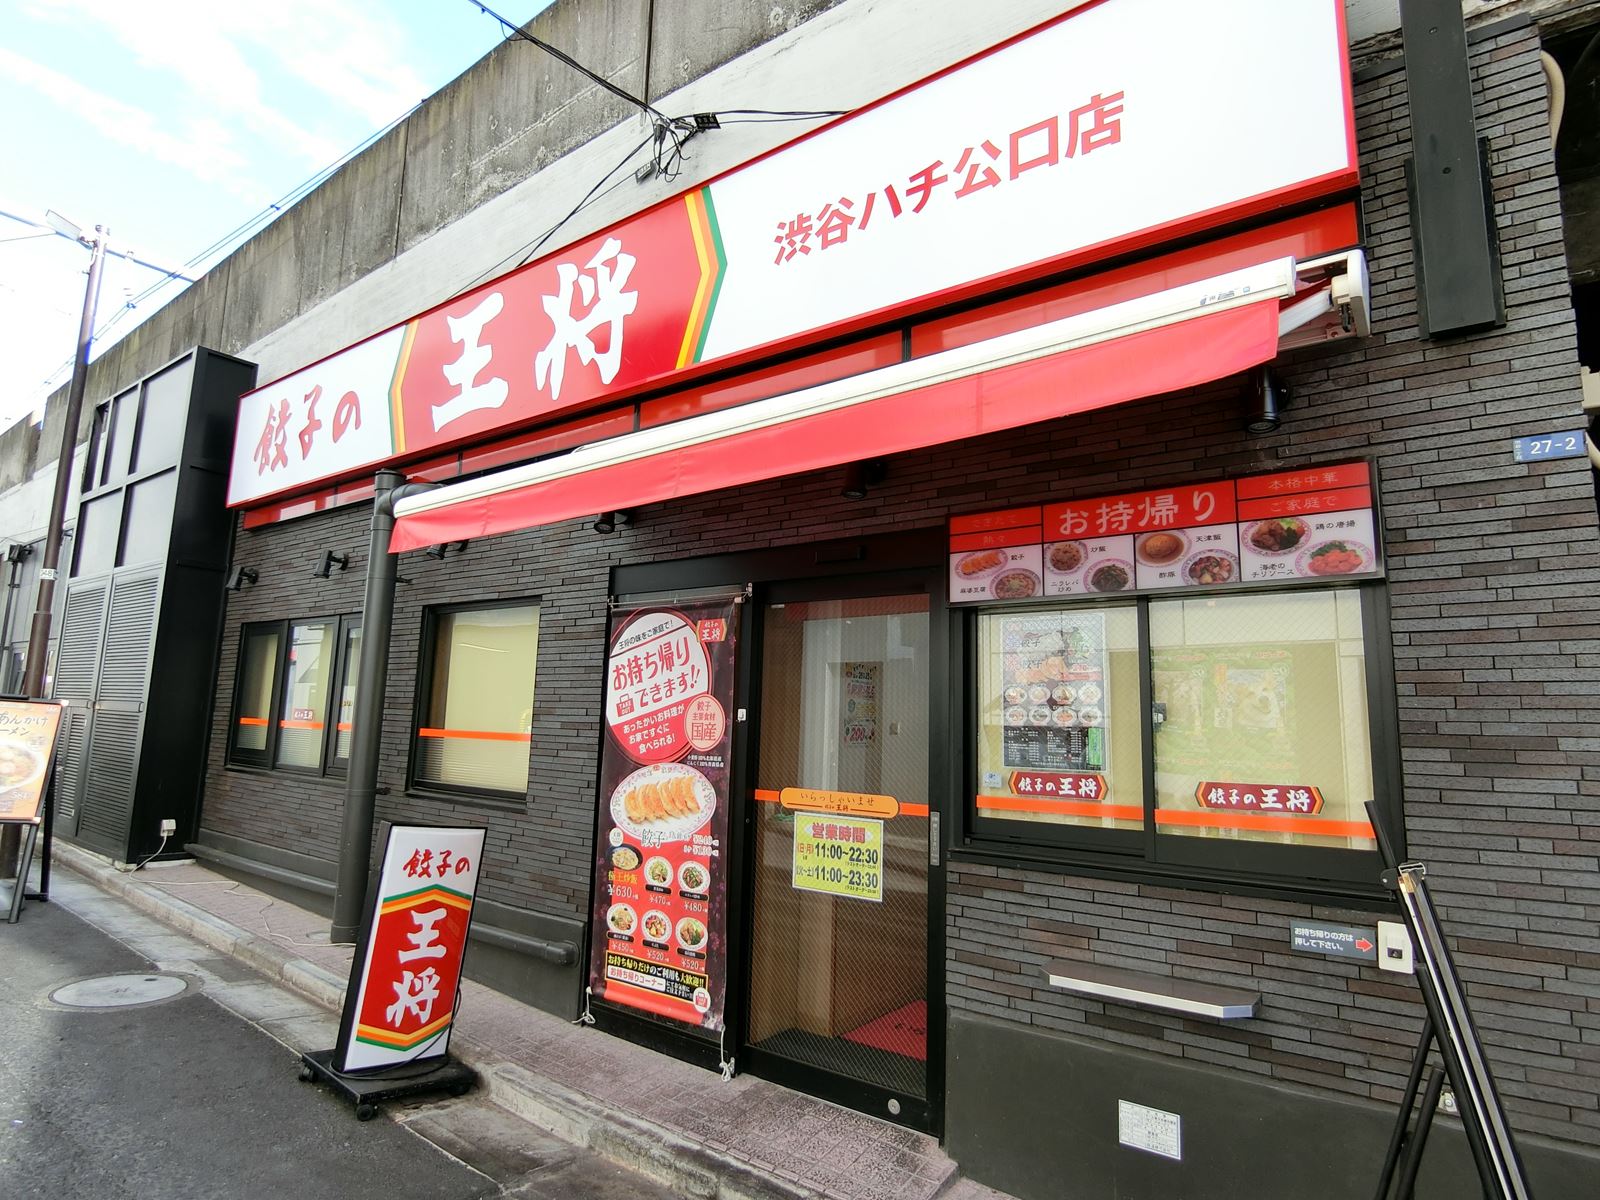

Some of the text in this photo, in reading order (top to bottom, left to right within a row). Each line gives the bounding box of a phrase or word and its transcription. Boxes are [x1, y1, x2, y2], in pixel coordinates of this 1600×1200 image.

[774, 90, 1125, 266] 渋谷ハチ公口店
[253, 237, 639, 476] 餃子の 王将
[1530, 437, 1577, 455] 27-2
[1269, 472, 1338, 489] 本格中華
[1059, 490, 1216, 537] お持帰り
[701, 629, 721, 641] 王将
[612, 636, 691, 691] お持ち帰り
[691, 722, 717, 741] 国産
[1018, 777, 1098, 797] 餃子の王将
[801, 792, 874, 806] いらっしゃいませ
[1208, 788, 1311, 811] 餃子の王将
[812, 822, 866, 844] 営業時間
[403, 848, 471, 879] 餃子の
[1294, 927, 1354, 942] お持ち帰りの方は
[386, 907, 448, 1028] 王将
